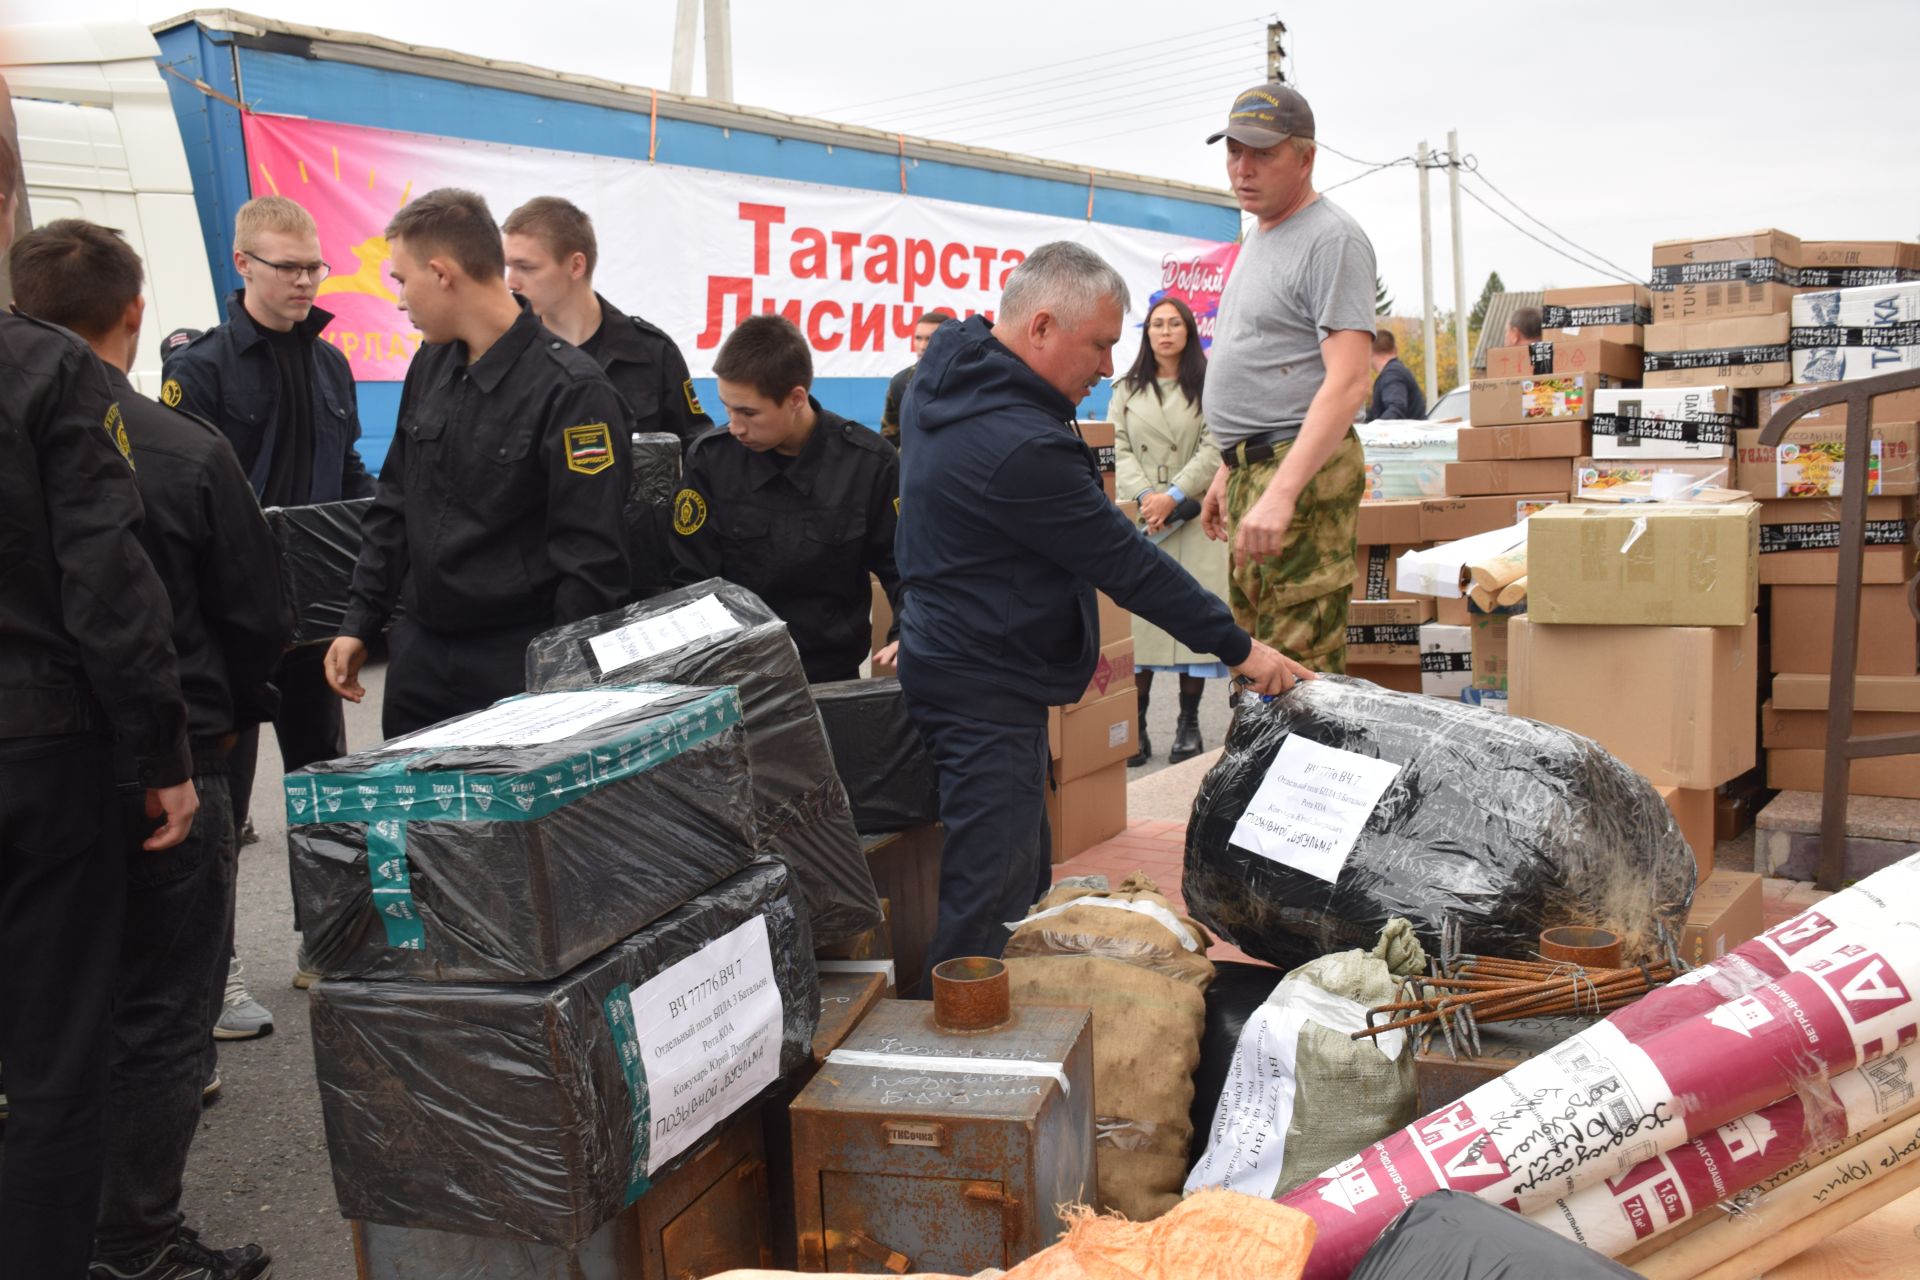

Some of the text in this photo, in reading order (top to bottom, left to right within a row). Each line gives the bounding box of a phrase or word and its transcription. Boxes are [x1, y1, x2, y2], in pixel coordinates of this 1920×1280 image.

[1161, 253, 1226, 299] Добрый
[668, 994, 688, 1019] ВЧ
[736, 958, 743, 976] 7
[654, 1024, 697, 1059] Отдельный
[696, 1014, 714, 1033] полк
[712, 1000, 734, 1020] БПЛА
[737, 976, 768, 1002] Батальон
[702, 1021, 736, 1053] Рота КОА
[673, 1066, 709, 1098] Кожухарь
[709, 1049, 732, 1074] Юрий
[655, 1078, 719, 1141] ПОЗЫВНОЙ
[1246, 1056, 1281, 1169] ВЧ 77776 ВЧ 7
[1627, 1198, 1645, 1219] 70
[1660, 1183, 1677, 1205] 1,6
